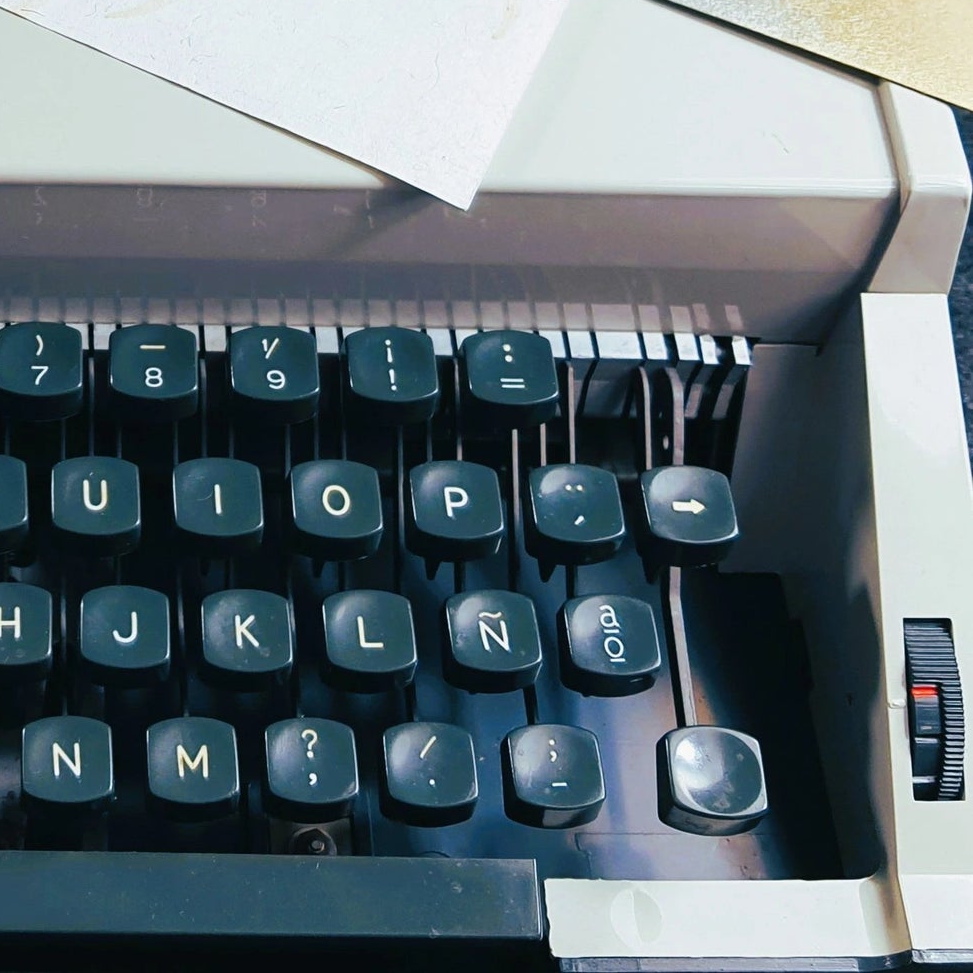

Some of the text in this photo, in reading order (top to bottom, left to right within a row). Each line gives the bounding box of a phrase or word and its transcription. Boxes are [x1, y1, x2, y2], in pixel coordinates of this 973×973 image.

[35, 334, 44, 356] )
[31, 365, 49, 385] 7
[145, 367, 164, 388] 8
[266, 369, 286, 390] 9
[500, 377, 526, 389] =
[82, 479, 108, 511] U
[322, 484, 351, 516] O
[443, 486, 469, 518] P
[112, 611, 138, 644] J
[234, 614, 260, 649] K
[357, 615, 384, 649] L
[478, 610, 510, 652] Ñ
[52, 742, 81, 777] N
[176, 744, 209, 778] M
[301, 729, 318, 759] ?
